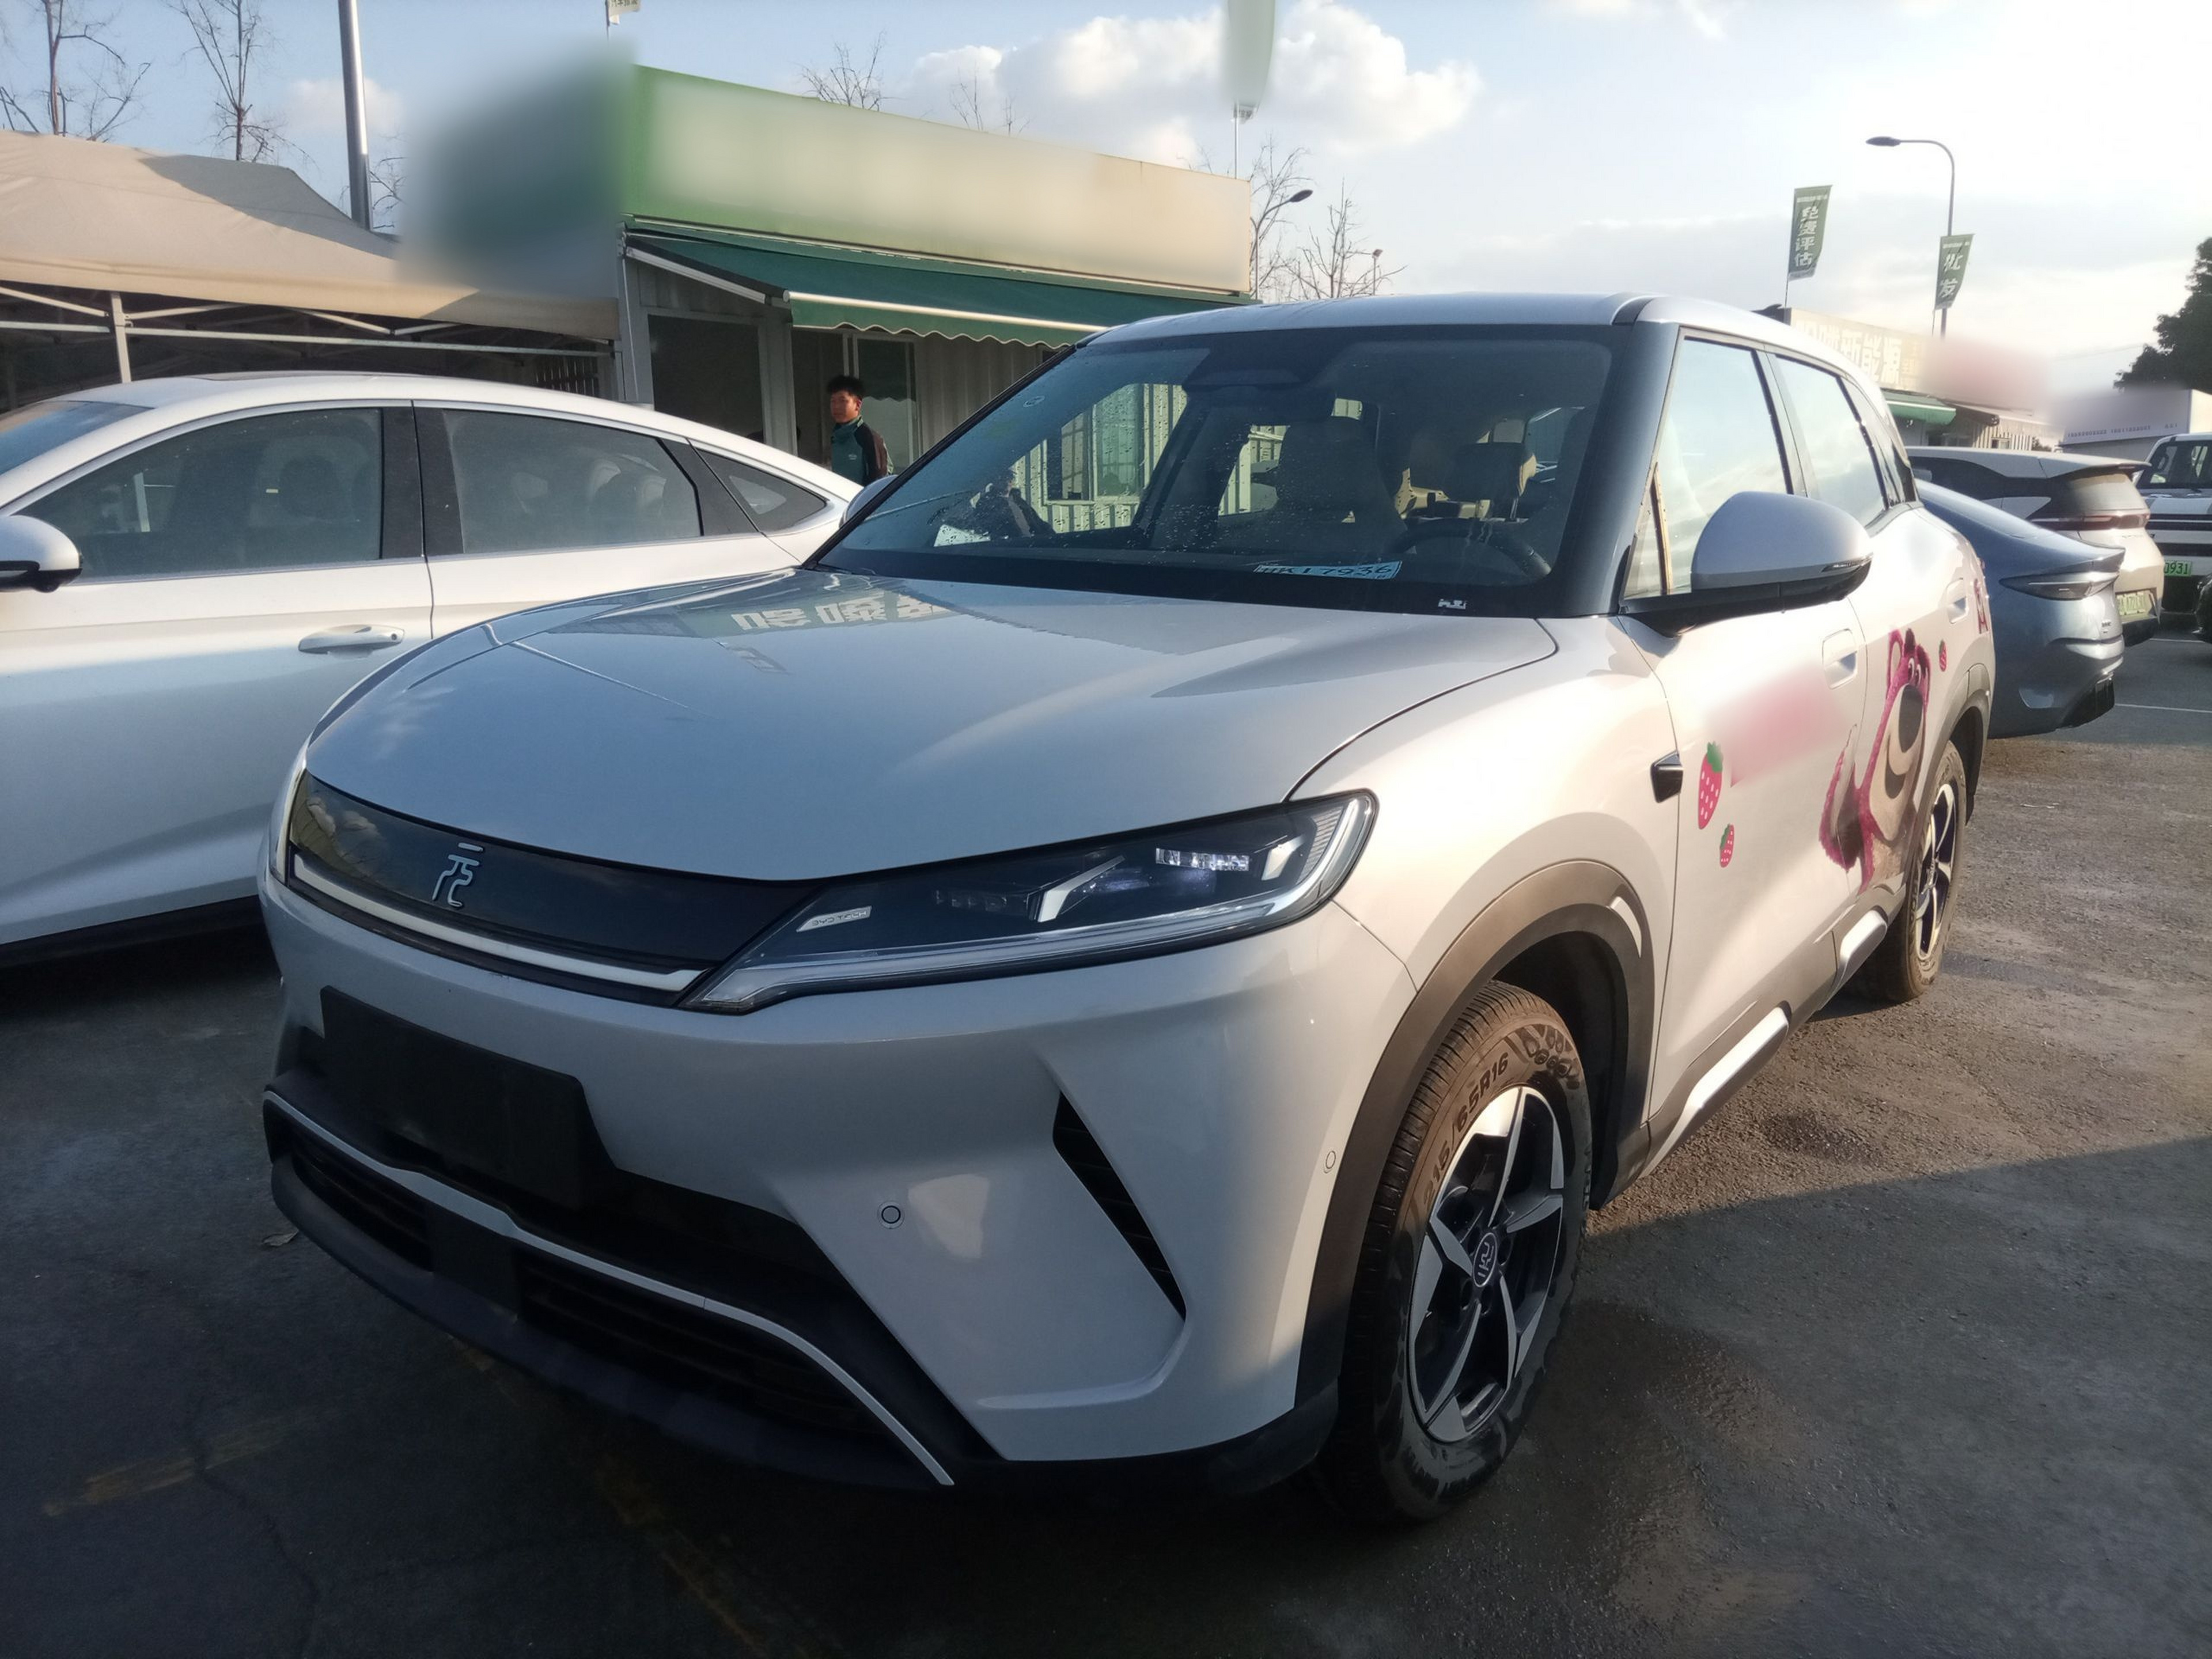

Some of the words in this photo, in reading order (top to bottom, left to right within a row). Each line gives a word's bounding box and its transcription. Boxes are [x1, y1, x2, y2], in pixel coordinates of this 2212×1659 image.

[812, 916, 835, 926] BYD
[837, 910, 867, 920] TECH
[1423, 1052, 1509, 1209] 215/65R16
